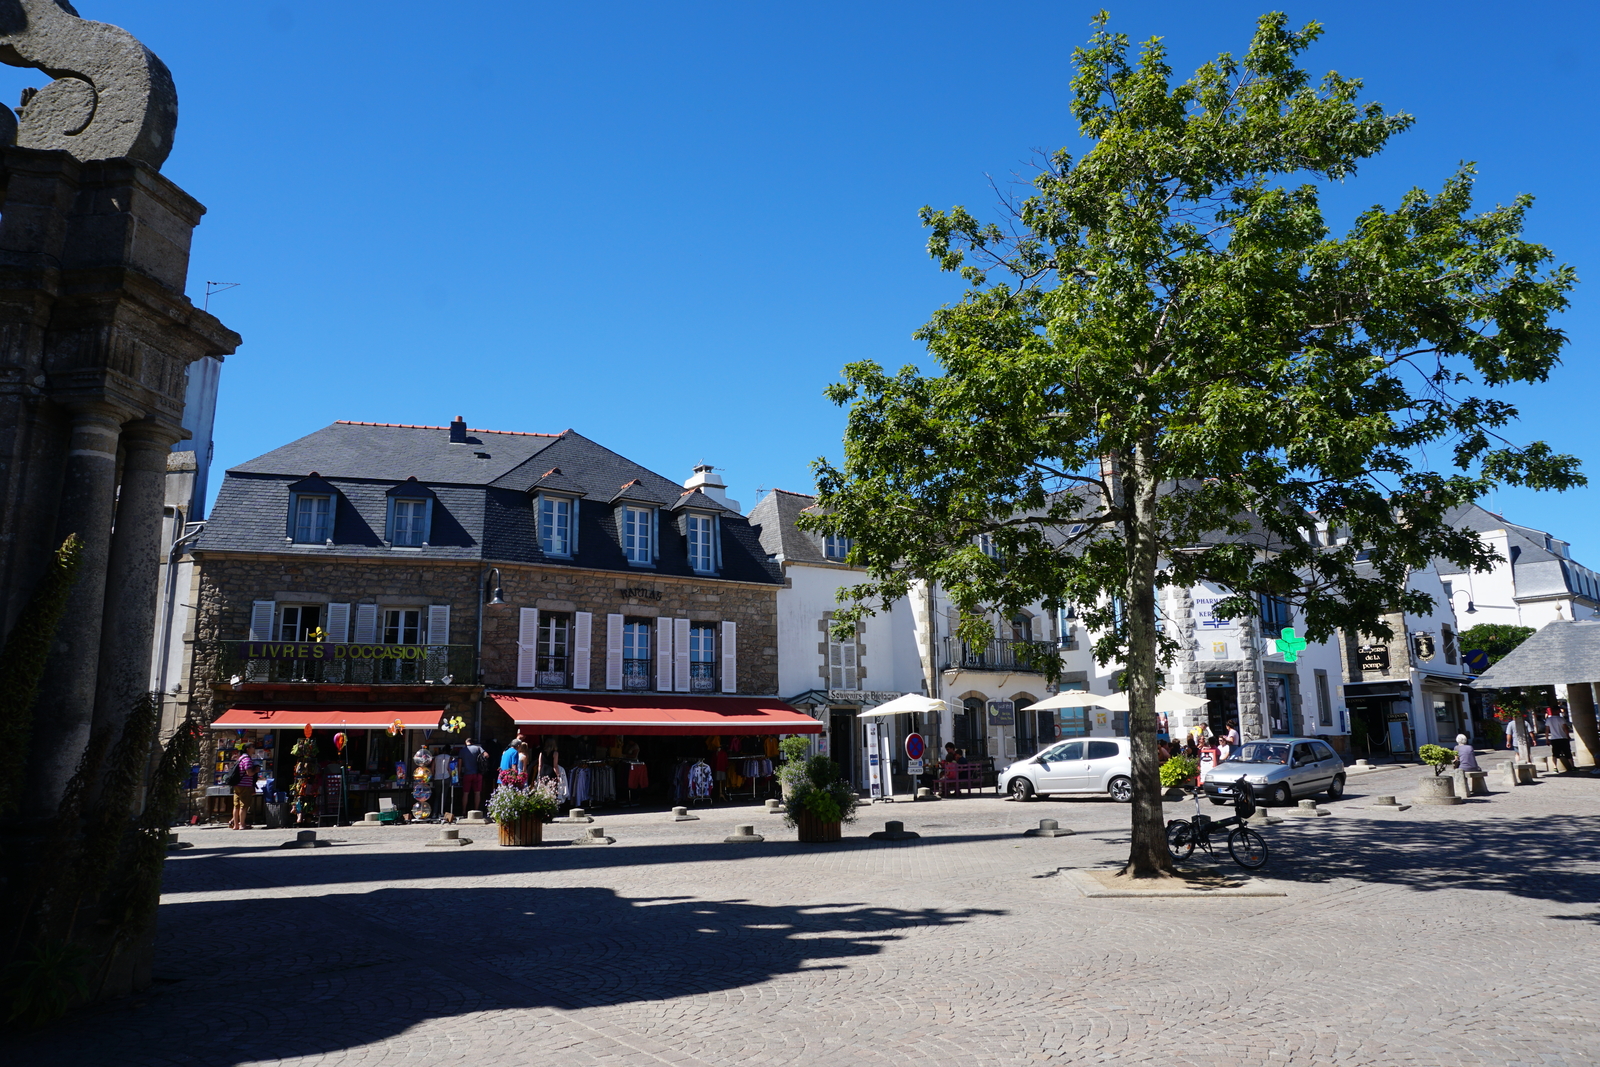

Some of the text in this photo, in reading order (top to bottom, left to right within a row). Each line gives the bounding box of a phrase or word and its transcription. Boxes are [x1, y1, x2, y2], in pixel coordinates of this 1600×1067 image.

[249, 644, 427, 660] LIVRES D'OCCASION
[831, 690, 862, 700] Souvenirs
